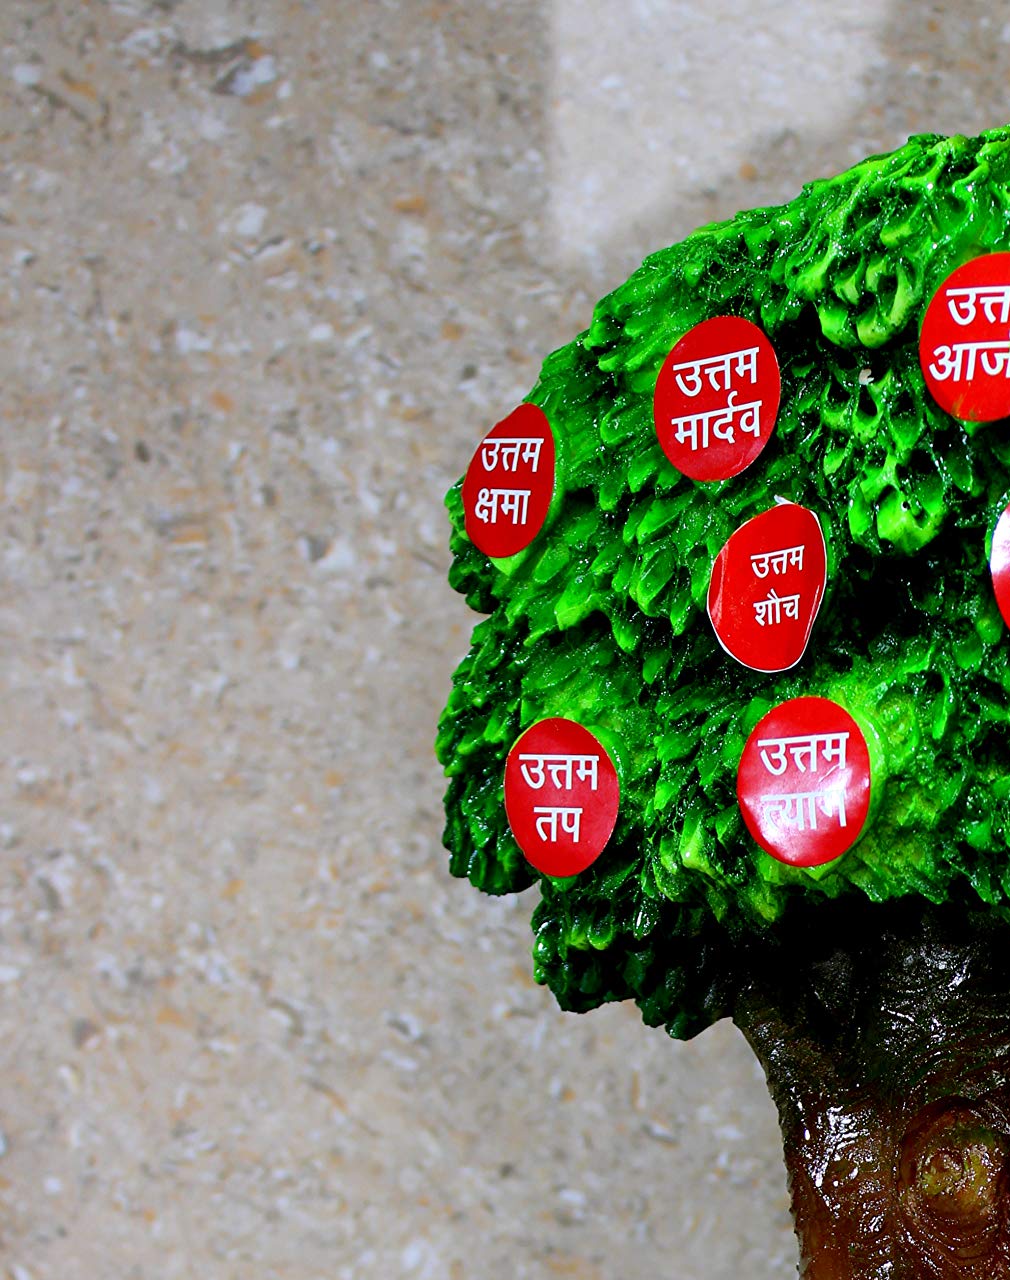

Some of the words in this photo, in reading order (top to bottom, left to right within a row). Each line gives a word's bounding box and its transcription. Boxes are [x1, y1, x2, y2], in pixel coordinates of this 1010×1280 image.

[673, 347, 759, 397] उत्तम
[671, 391, 763, 450] मार्दव
[481, 438, 544, 472] उत्तम
[475, 488, 531, 525] क्षमा
[751, 546, 804, 578] उत्तम
[753, 589, 800, 626] शौच
[519, 754, 599, 790] उत्तम
[758, 732, 850, 775] उत्तम
[534, 807, 582, 843] तप
